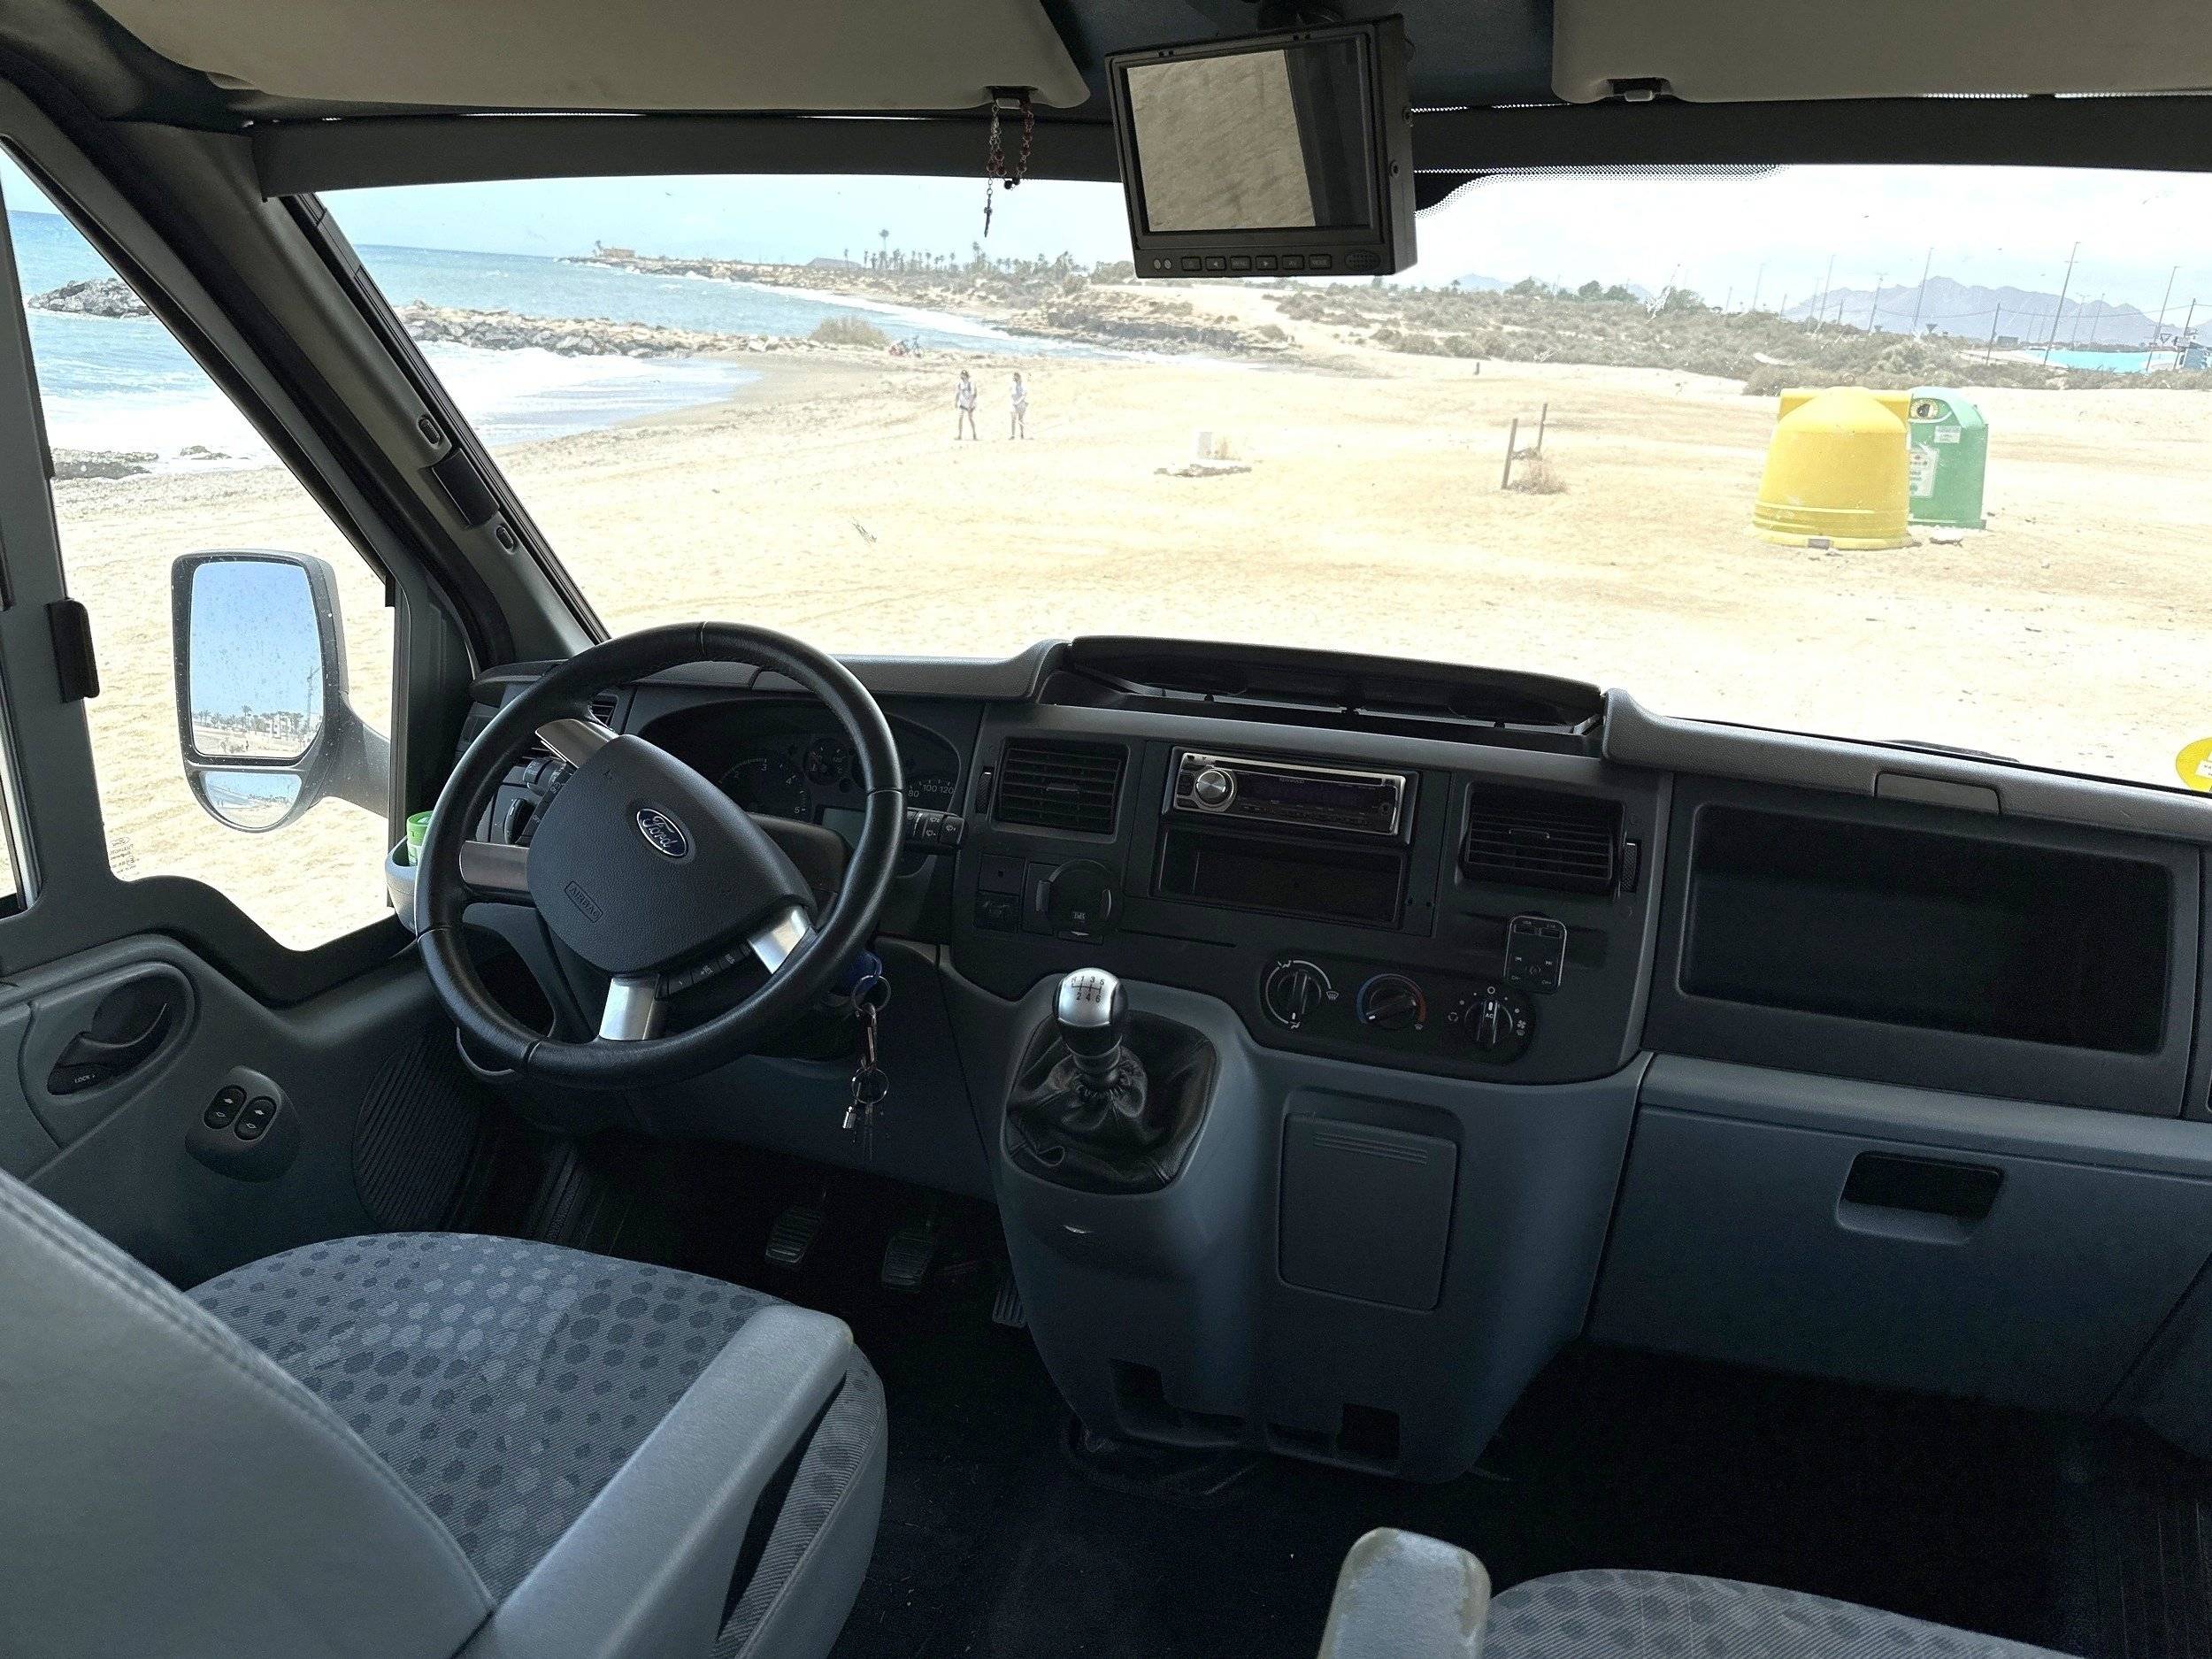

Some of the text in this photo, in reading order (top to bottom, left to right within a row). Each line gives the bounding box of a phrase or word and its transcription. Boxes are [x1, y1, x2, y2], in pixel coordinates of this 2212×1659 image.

[923, 784, 938, 793] 100
[940, 786, 955, 795] 120
[642, 816, 678, 848] Ford
[569, 887, 599, 918] AIRBAG
[74, 1075, 90, 1084] LOCK
